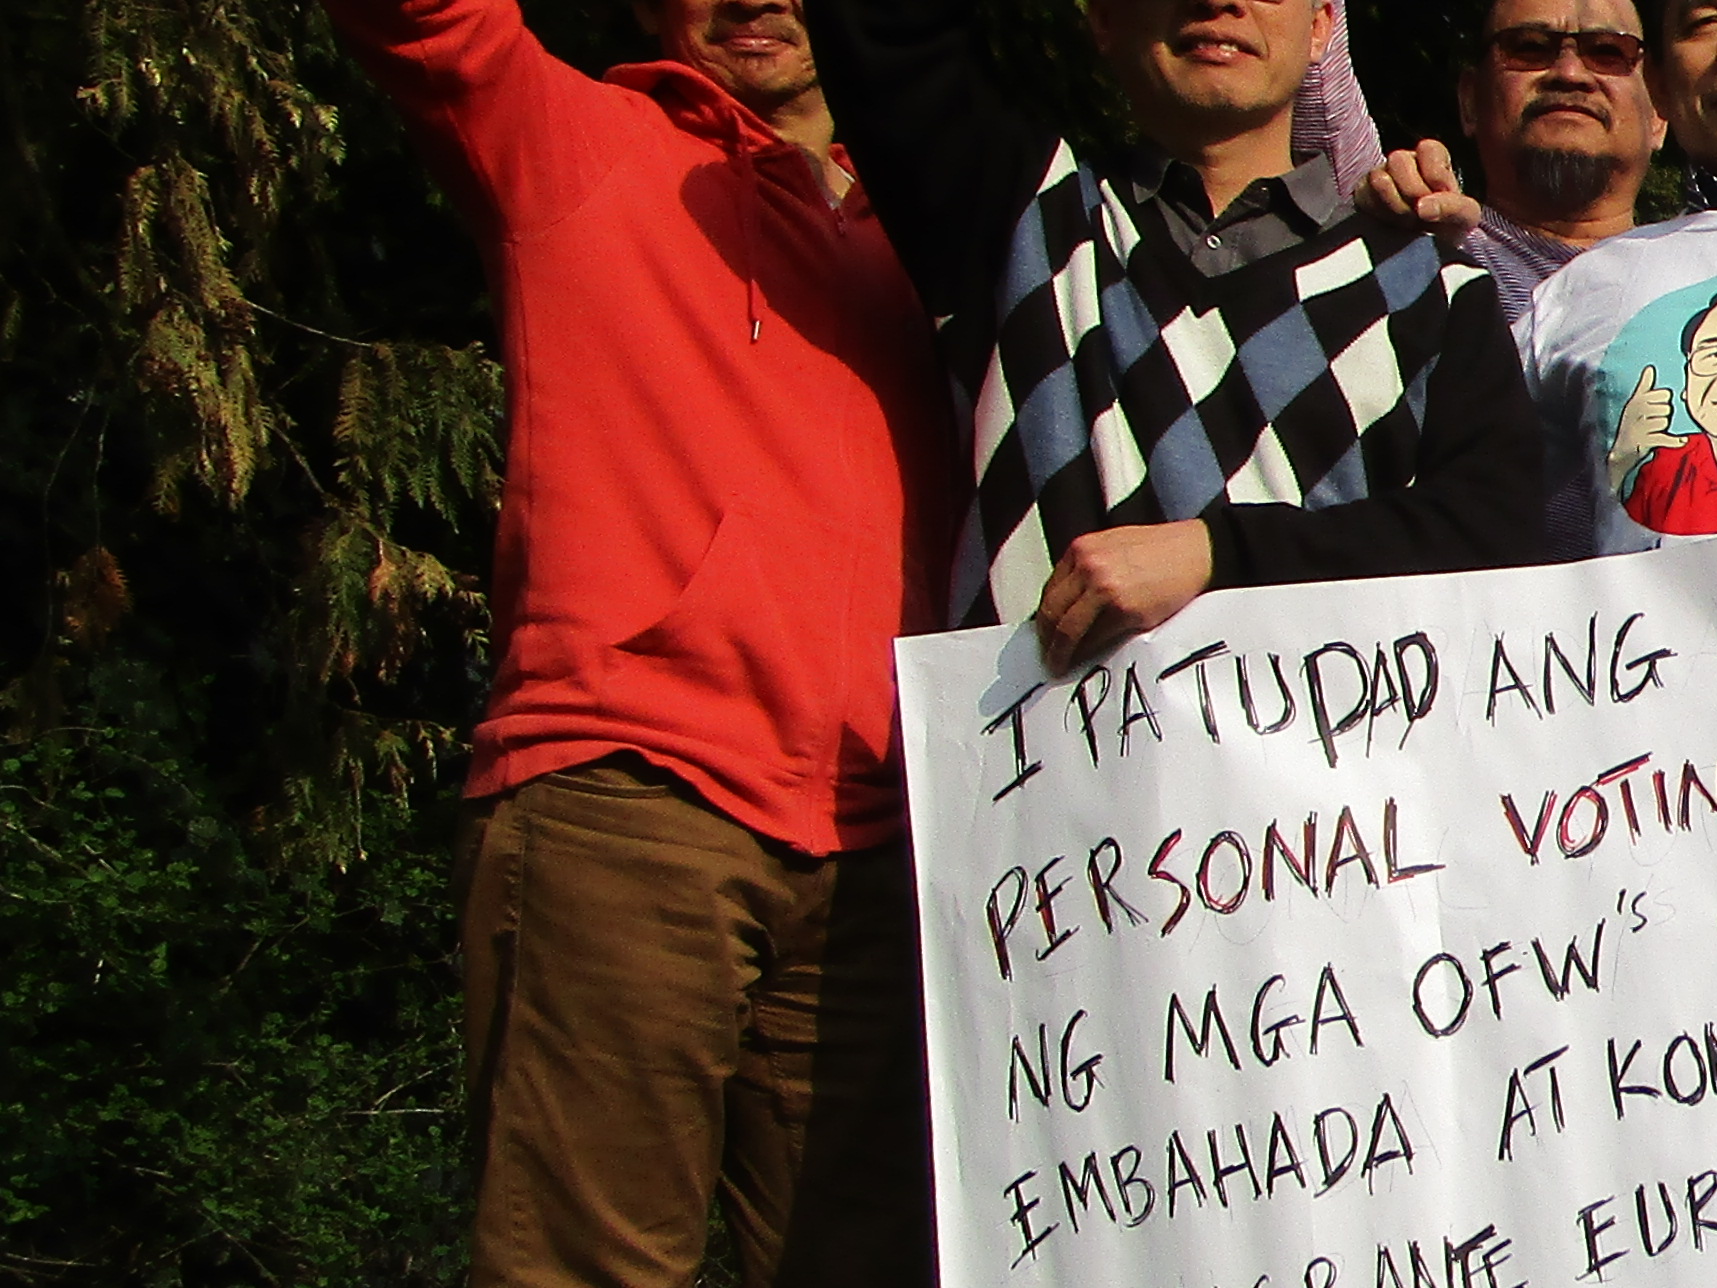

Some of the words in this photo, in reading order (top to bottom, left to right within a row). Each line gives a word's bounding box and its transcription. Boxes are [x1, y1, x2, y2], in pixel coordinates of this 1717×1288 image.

[1485, 611, 1679, 726] ANG
[984, 796, 1447, 983] PERSONAL
[1007, 1008, 1106, 1124] NG
[1164, 961, 1364, 1084] MGA
[1002, 1091, 1416, 1271] EMBAHADA
[1497, 1045, 1570, 1162] AT
